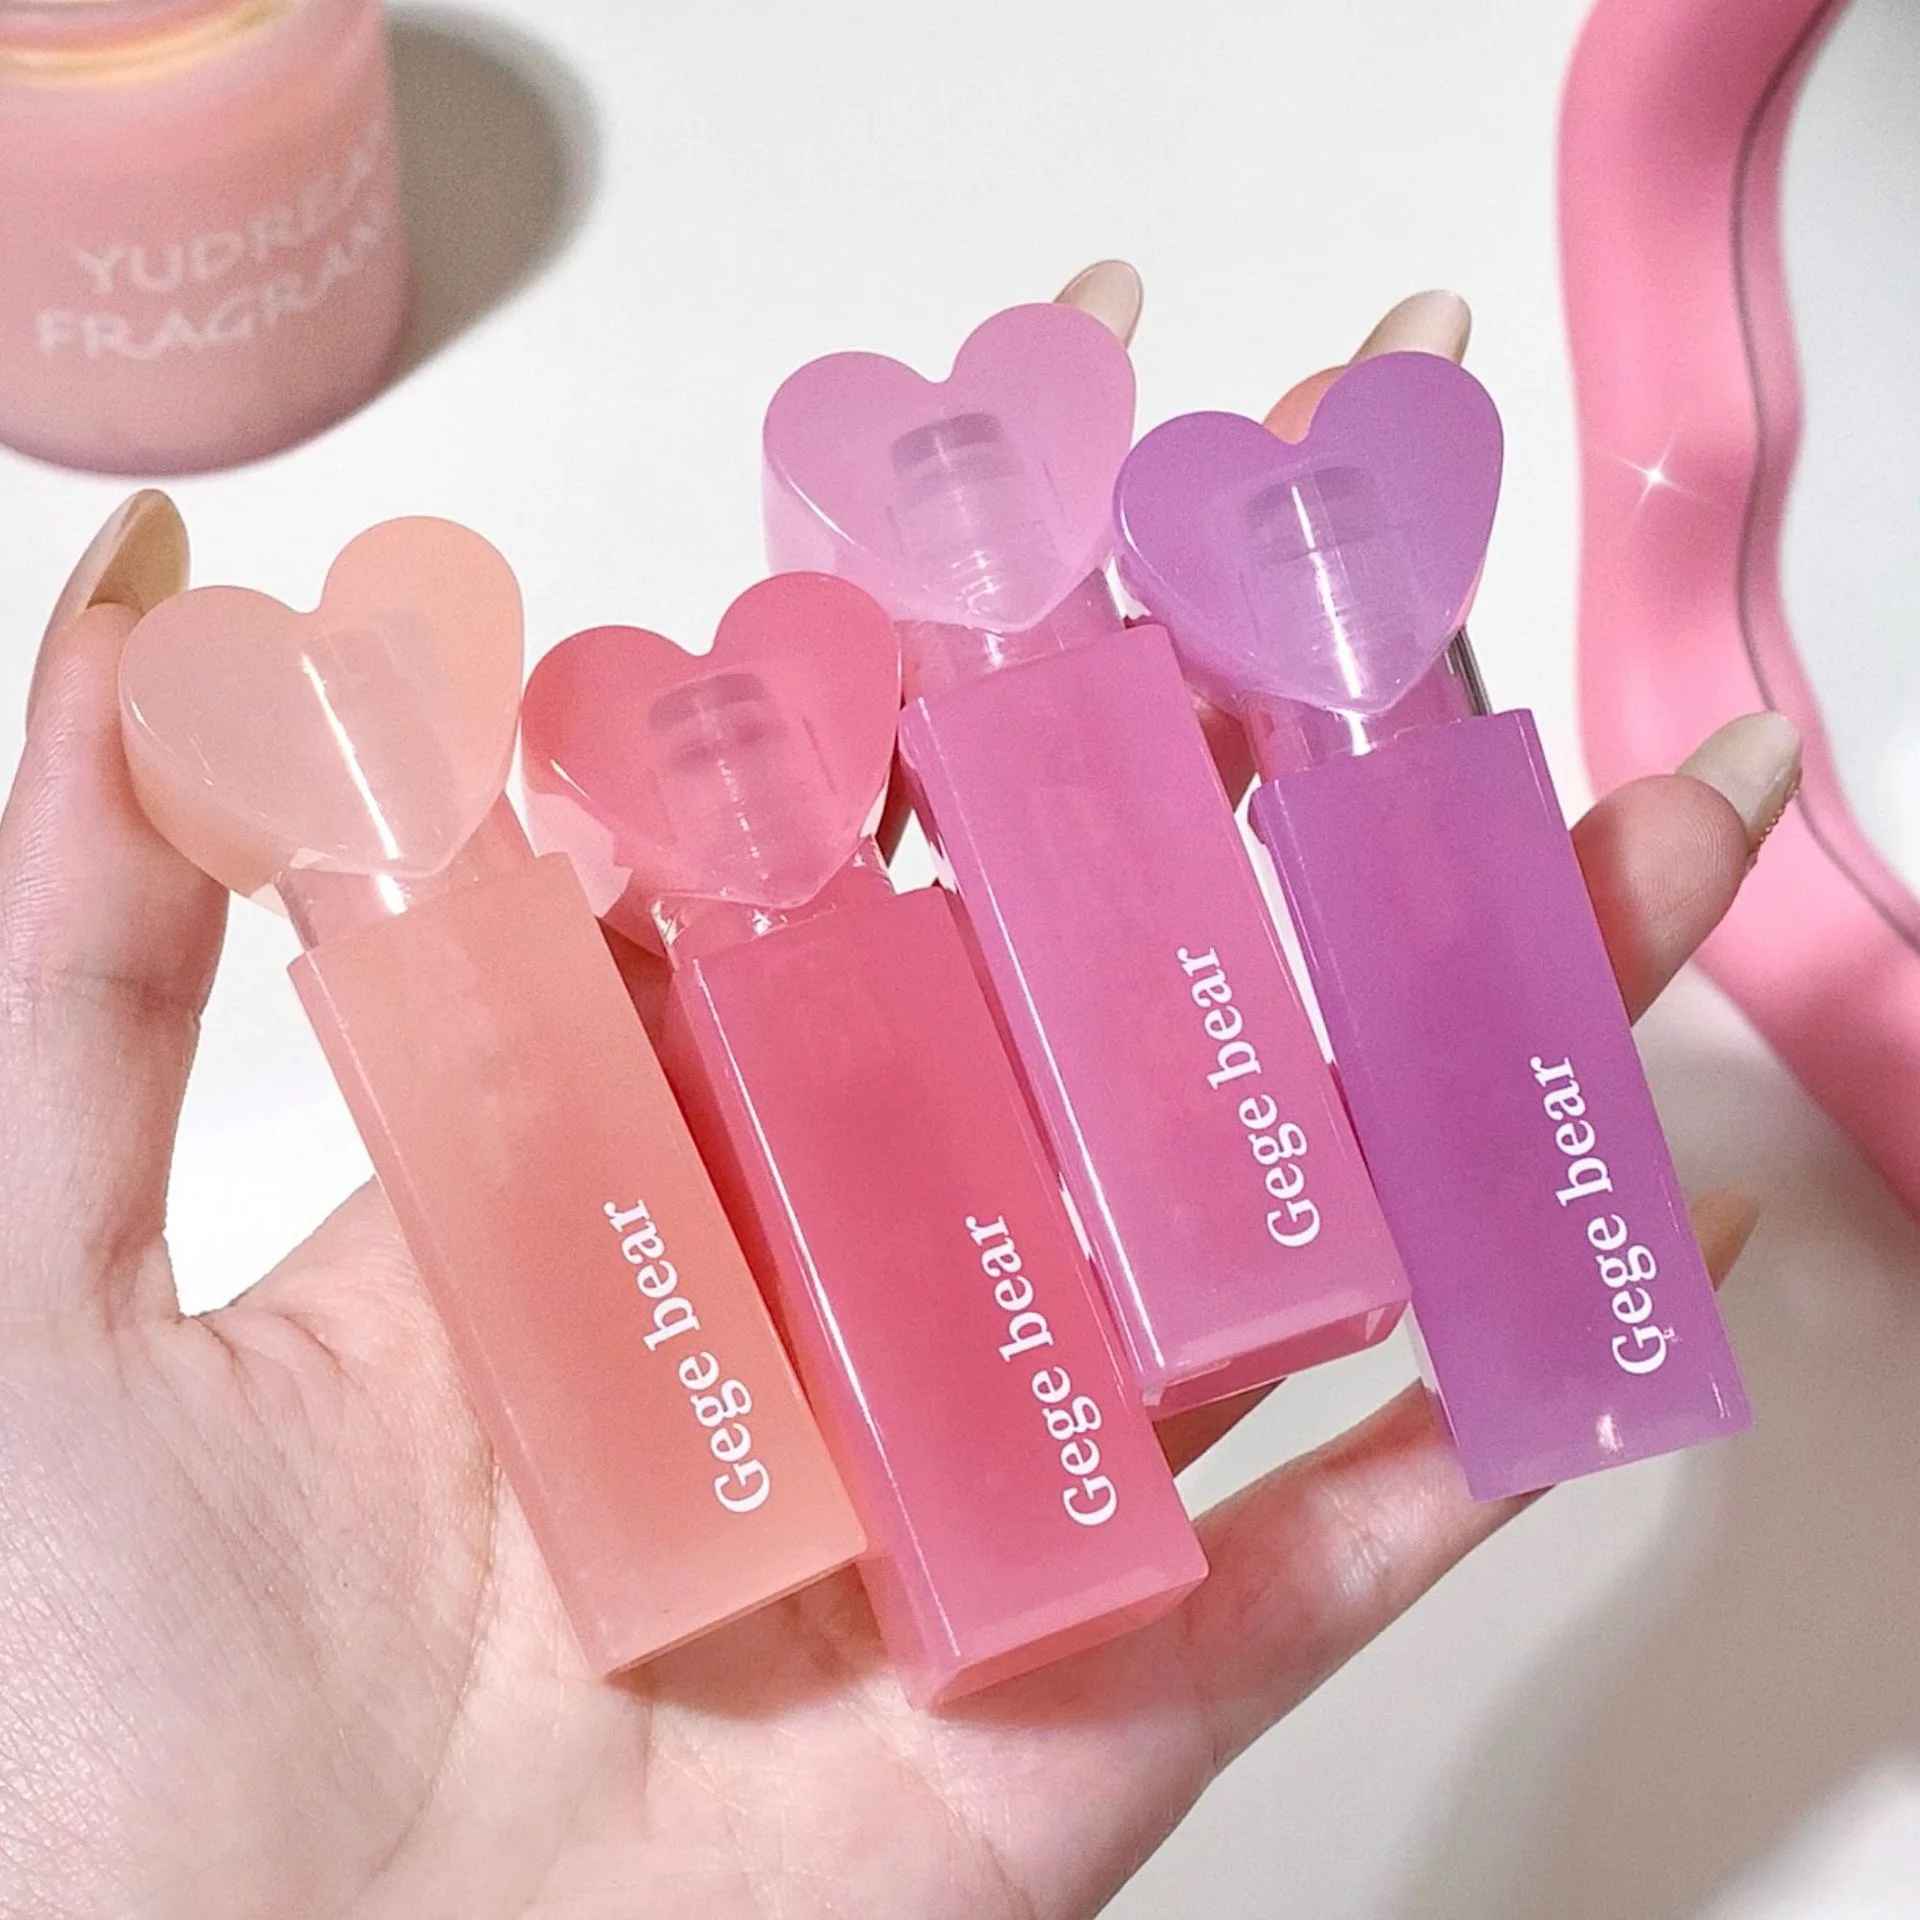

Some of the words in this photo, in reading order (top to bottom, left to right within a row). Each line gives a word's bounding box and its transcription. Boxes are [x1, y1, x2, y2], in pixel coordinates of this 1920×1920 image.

[1177, 947, 1261, 1089] bear
[1239, 1094, 1320, 1248] Gege
[1529, 1057, 1613, 1206] bear
[603, 1198, 701, 1352] bear
[965, 1216, 1054, 1361] bear
[1587, 1214, 1669, 1374] Gege
[678, 1351, 771, 1514] Gege
[1032, 1367, 1118, 1526] Gege
